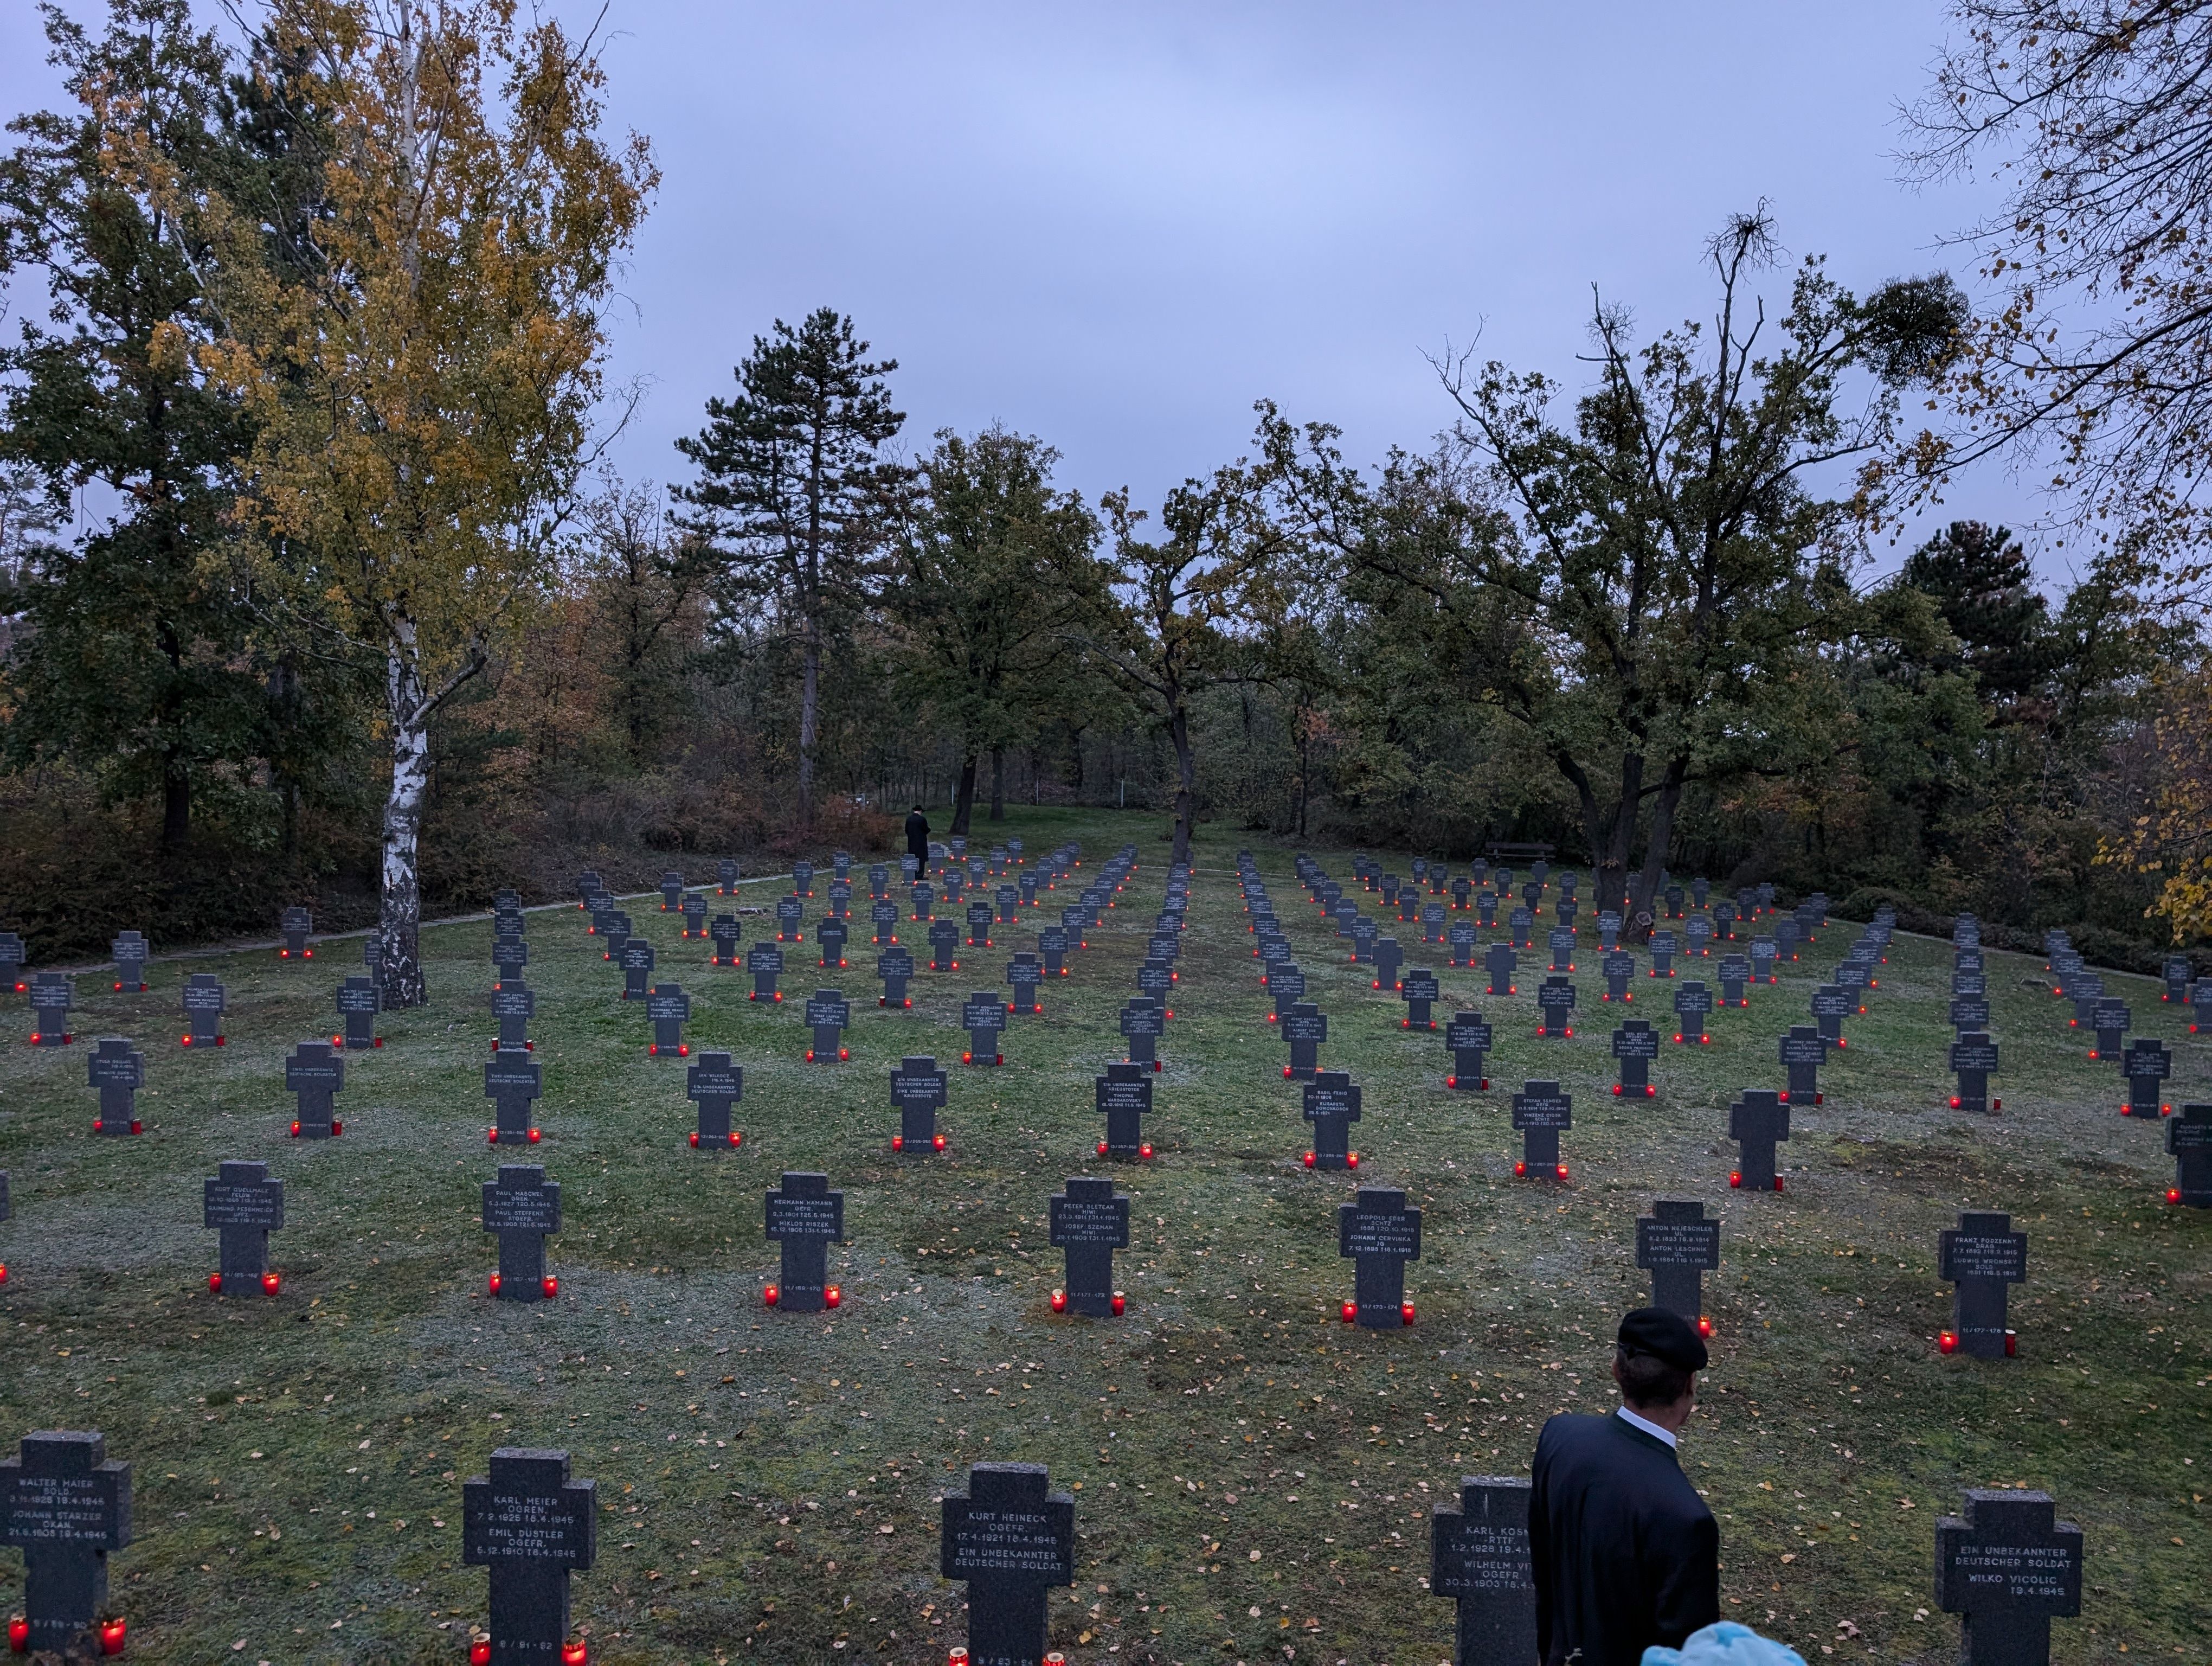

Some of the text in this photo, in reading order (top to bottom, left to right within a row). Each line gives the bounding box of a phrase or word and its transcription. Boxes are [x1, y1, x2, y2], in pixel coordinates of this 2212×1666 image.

[19, 1478, 94, 1488] WALTER MAIER
[494, 1496, 558, 1507] KARL MEIER
[13, 1510, 52, 1519] JOHANN
[969, 1511, 1047, 1523] KURT HEINECK
[489, 1528, 513, 1537] EMIL
[989, 1523, 1028, 1533] OGEFR.
[1466, 1526, 1495, 1535] KARL
[508, 1538, 546, 1548] OGEFR.
[959, 1547, 1058, 1560] EIN UNBEKANNTER
[1960, 1546, 2067, 1557] EIN UNBEKANNTER
[955, 1558, 1063, 1571] DEUTSCHER SOLDAT
[1464, 1560, 1511, 1569] WILHELM
[1955, 1556, 2072, 1568] DEUTSCHER SOLDAT
[1969, 1573, 2003, 1583] WILKO
